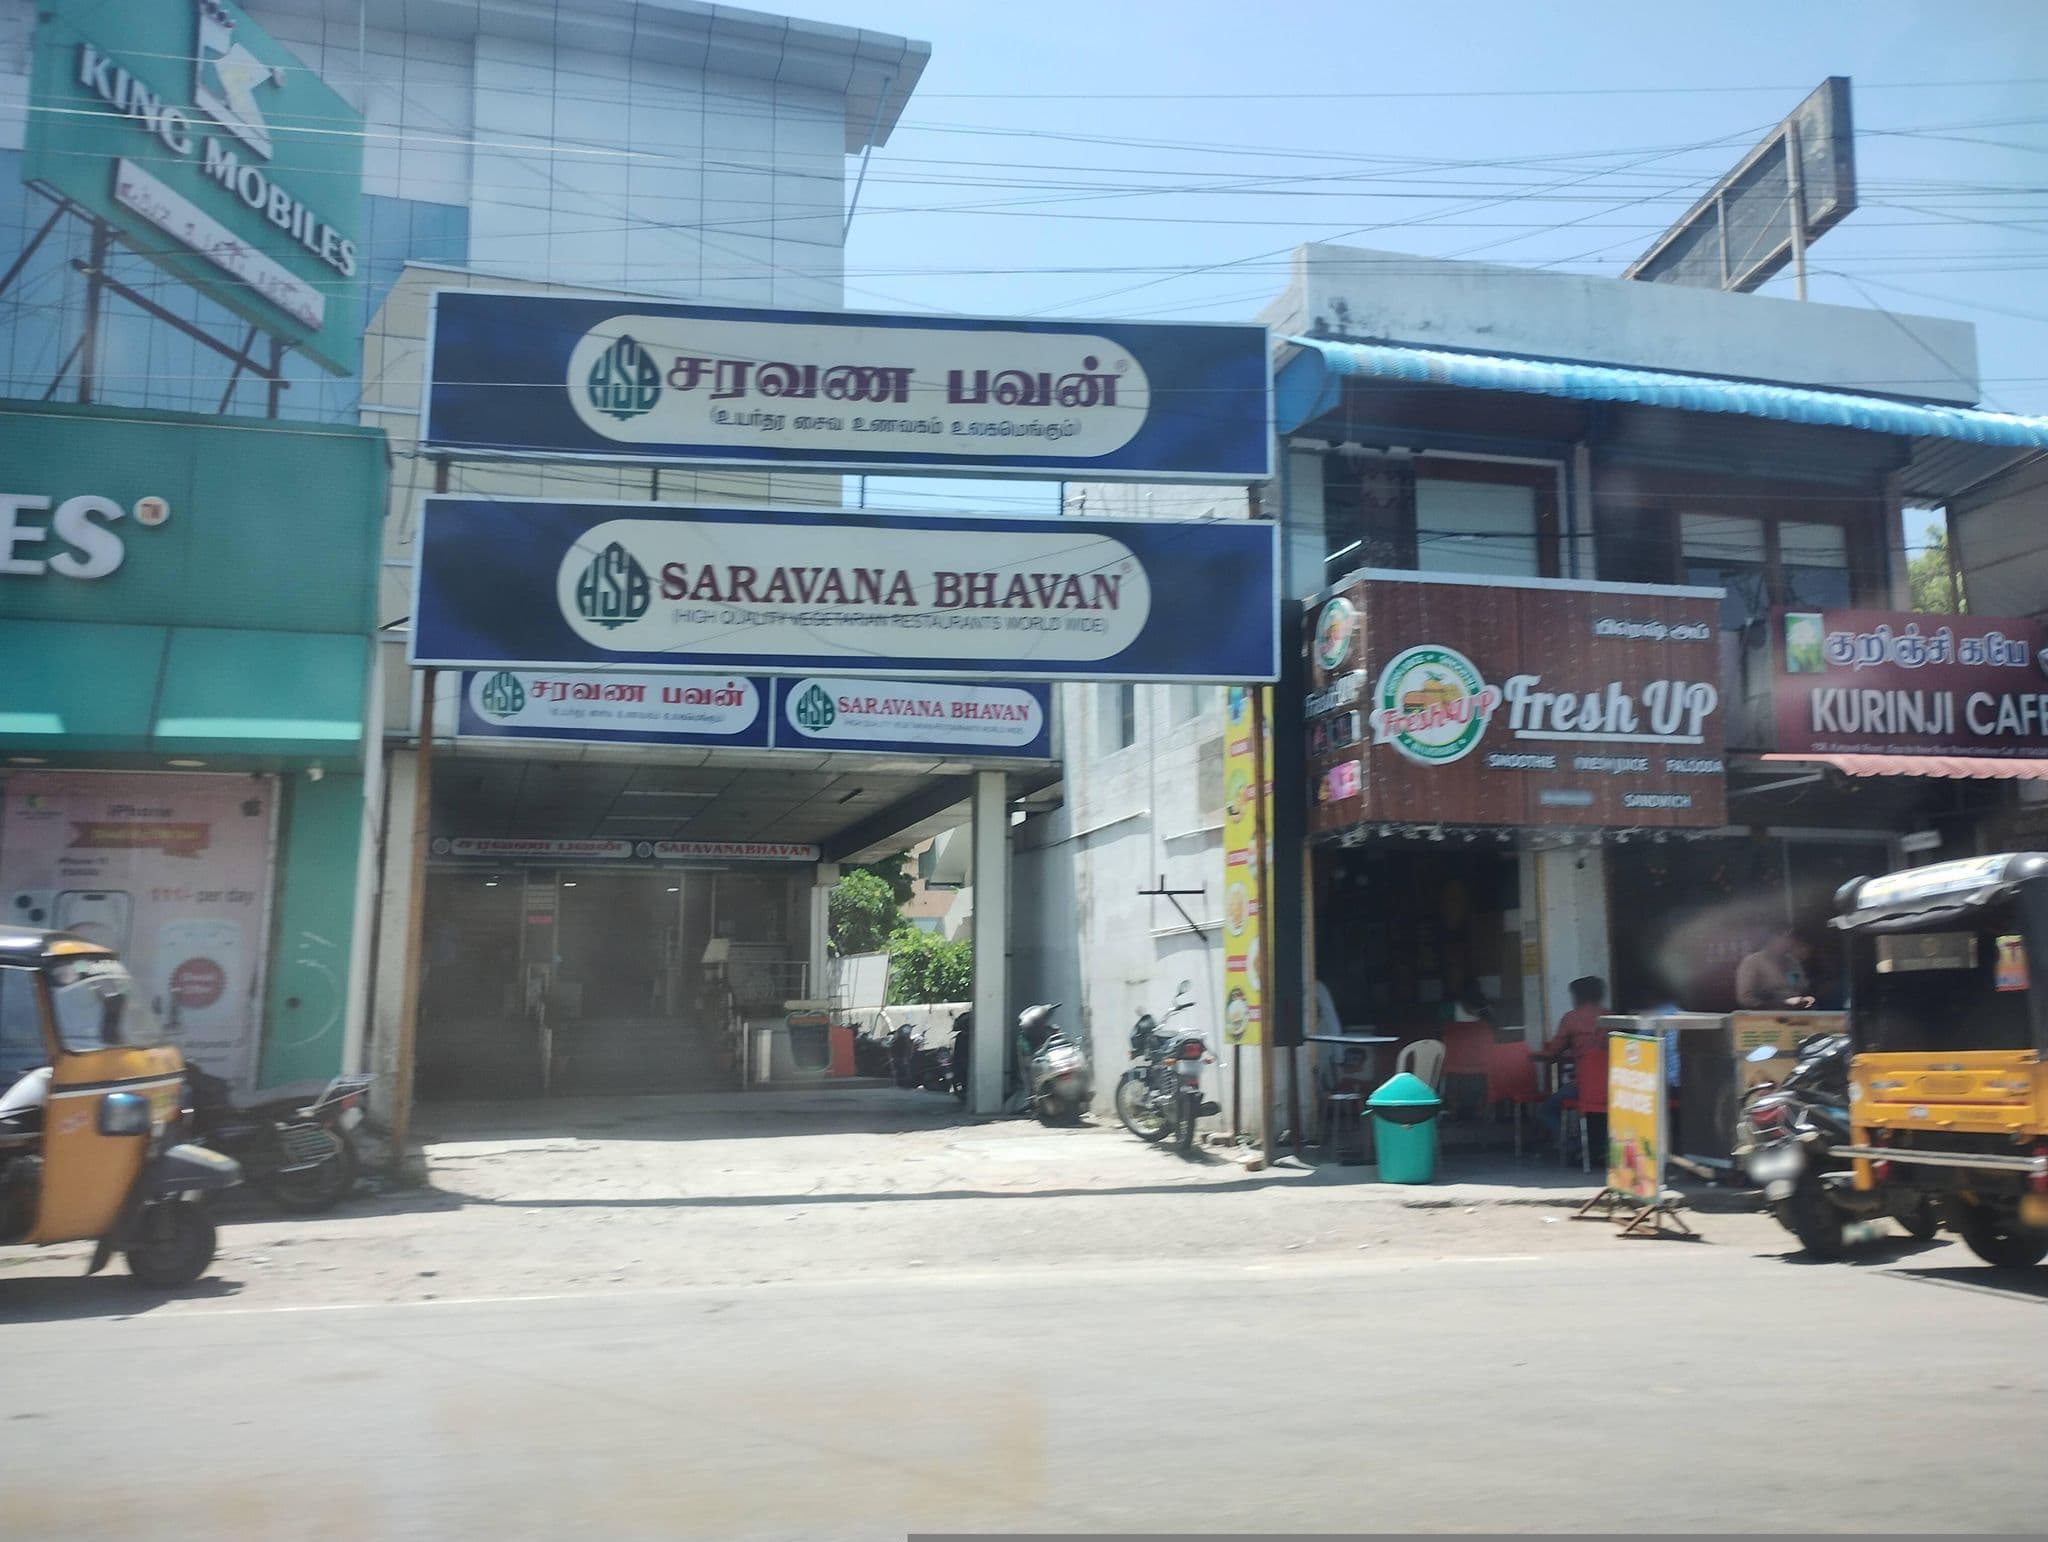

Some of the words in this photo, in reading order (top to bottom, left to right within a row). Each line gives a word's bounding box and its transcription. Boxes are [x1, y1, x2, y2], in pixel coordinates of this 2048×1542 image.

[80, 42, 194, 156] KING
[204, 137, 358, 279] MOBILES
[666, 356, 914, 404] சரவண
[947, 354, 1123, 408] பவன்
[660, 562, 923, 608] SARAVANA
[932, 571, 1122, 611] BHAVAN
[1006, 615, 1060, 631] WORLD
[1826, 623, 1954, 671] குறிஞ்சி
[1958, 631, 2030, 667] கபே
[529, 680, 647, 702] சரவண
[661, 681, 744, 708] பவன்
[837, 696, 945, 718] SARAVANA
[949, 702, 1030, 722] BHAVAN
[1503, 674, 1640, 733] Fresh
[1642, 679, 1719, 736] UP
[1812, 688, 1954, 734] KURINJI
